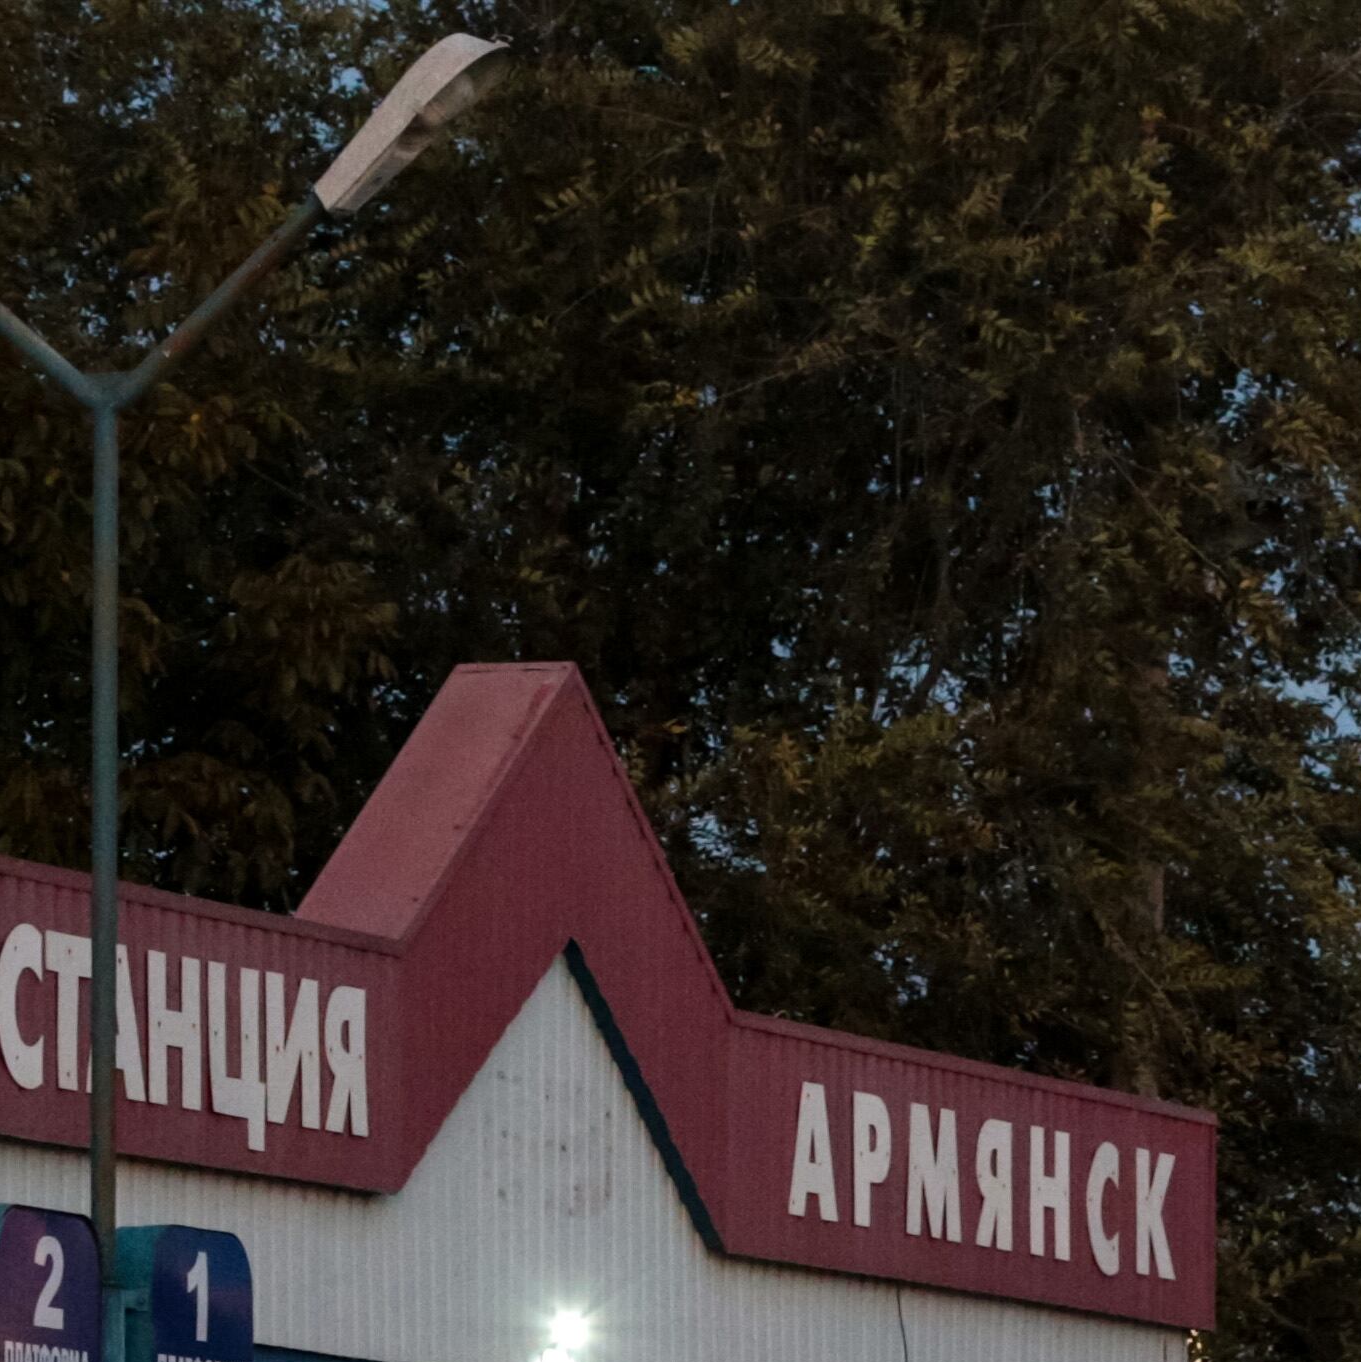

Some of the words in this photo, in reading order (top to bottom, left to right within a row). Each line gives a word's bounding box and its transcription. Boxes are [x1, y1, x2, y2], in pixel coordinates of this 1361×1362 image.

[788, 1081, 1177, 1281] АРМЯНСК
[33, 1235, 65, 1331] 2
[186, 1250, 209, 1342] 1
